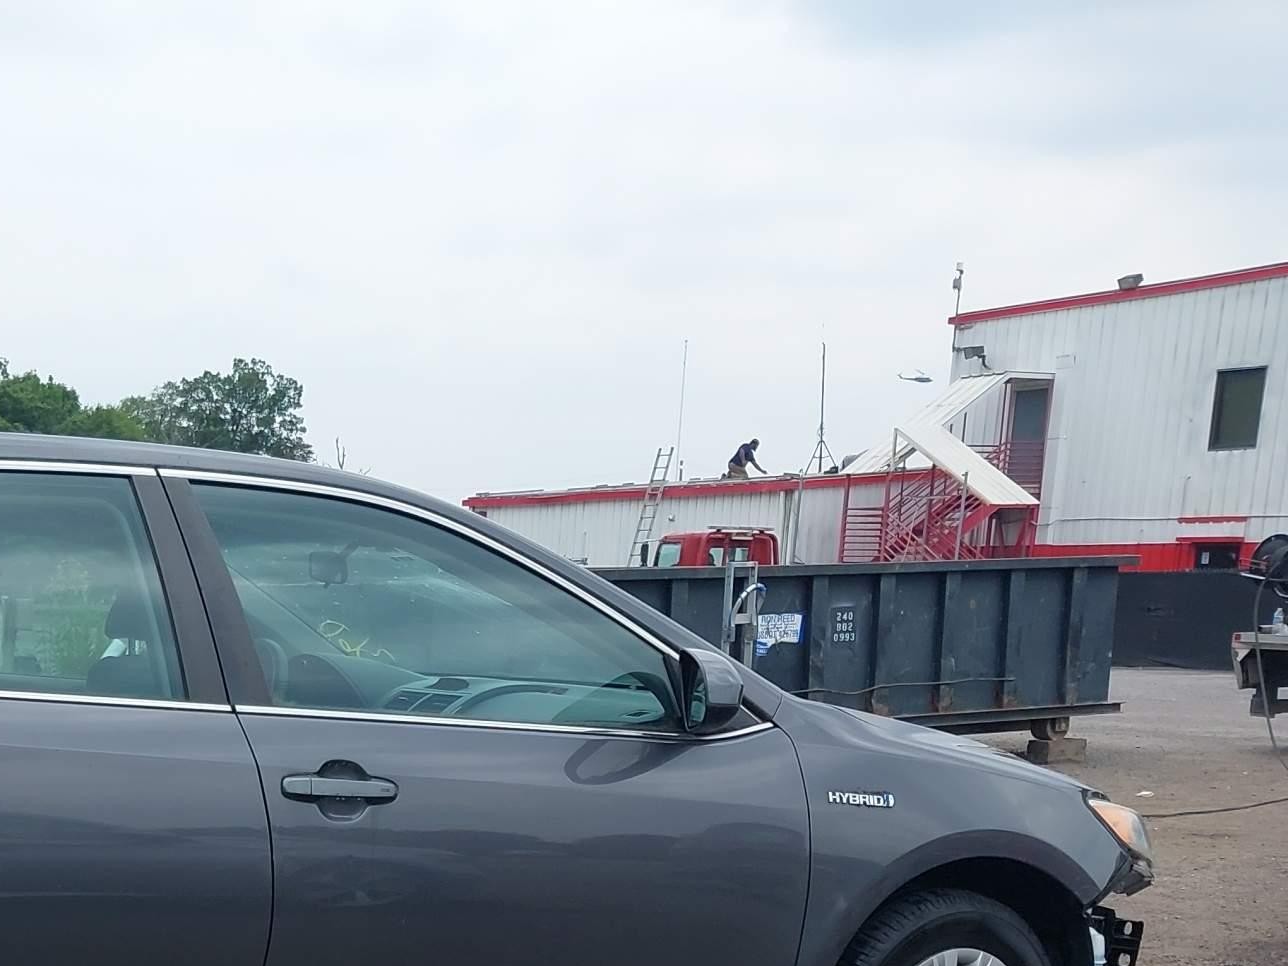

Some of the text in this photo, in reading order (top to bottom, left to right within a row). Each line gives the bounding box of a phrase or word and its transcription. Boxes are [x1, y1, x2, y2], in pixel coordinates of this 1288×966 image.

[836, 611, 853, 622] 240
[833, 632, 855, 642] 0993
[828, 791, 884, 807] HYBRID
